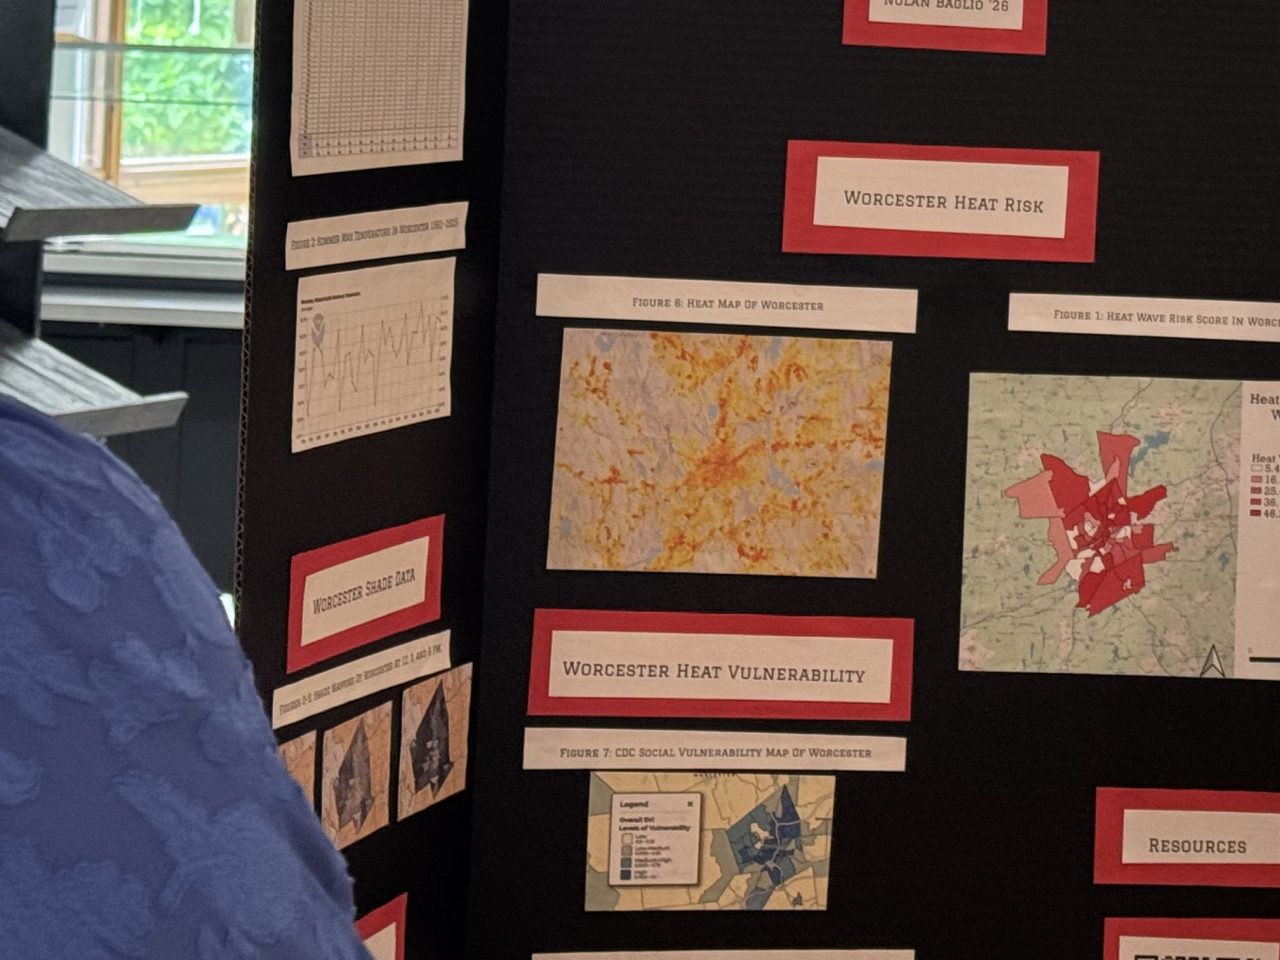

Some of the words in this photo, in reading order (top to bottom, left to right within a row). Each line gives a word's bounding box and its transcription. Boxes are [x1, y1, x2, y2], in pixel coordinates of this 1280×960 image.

[844, 191, 947, 209] WORCESTER
[954, 196, 998, 211] HEAT
[1005, 198, 1044, 213] RISK
[632, 297, 671, 308] FIGURE
[687, 298, 714, 309] HEAT
[718, 299, 742, 310] MAP
[745, 300, 757, 310] OF
[761, 300, 824, 312] WORCESTER
[1054, 309, 1091, 321] FIGURE
[1107, 311, 1133, 322] HEAT
[1137, 312, 1165, 323] WAVE
[1169, 313, 1193, 324] RISK
[1196, 314, 1228, 325] SCORE
[1232, 316, 1243, 326] IN
[1250, 393, 1280, 405] Heat
[1252, 453, 1276, 463] Heat
[313, 585, 363, 615] WORCESTER
[365, 575, 393, 596] SHADE
[395, 568, 415, 587] DATA
[563, 661, 669, 679] WORCESTER
[677, 663, 722, 680] HEAT
[728, 664, 866, 684] VULNERABILITY
[560, 748, 600, 758] FIGURE
[615, 748, 636, 758] CDC
[639, 748, 675, 758] SOCIAL
[678, 748, 763, 759] VULNERABILITY
[766, 748, 789, 759] MAP
[793, 748, 806, 758] OF
[809, 748, 872, 759] WORCESTER
[1149, 838, 1247, 854] RESOURCES
